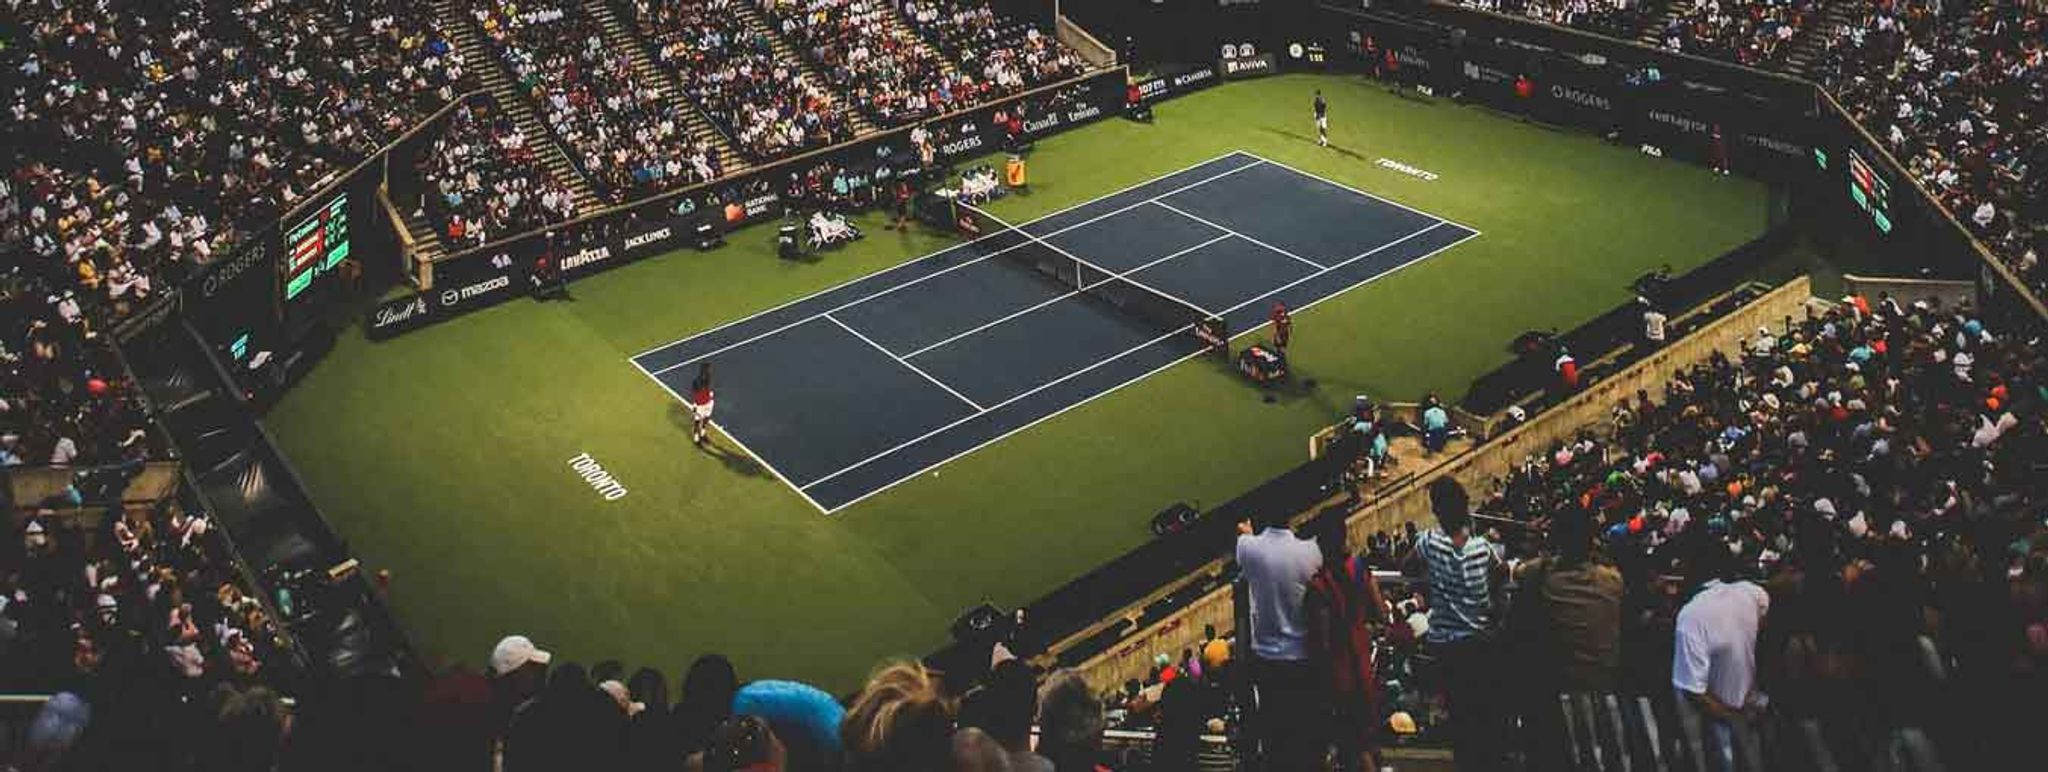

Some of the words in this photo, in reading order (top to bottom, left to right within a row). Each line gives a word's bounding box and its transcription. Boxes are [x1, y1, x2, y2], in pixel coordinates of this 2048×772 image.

[1240, 60, 1269, 72] AVIVA
[1068, 106, 1100, 122] Emirates
[943, 135, 983, 156] ROGERS
[1374, 158, 1439, 181] TORONTO
[745, 192, 778, 208] NATIONAL
[218, 241, 266, 281] ROGERS
[561, 246, 611, 271] LAVAZZA
[461, 276, 510, 300] mazda
[374, 302, 415, 328] Lindt
[567, 452, 628, 501] TORONTO
